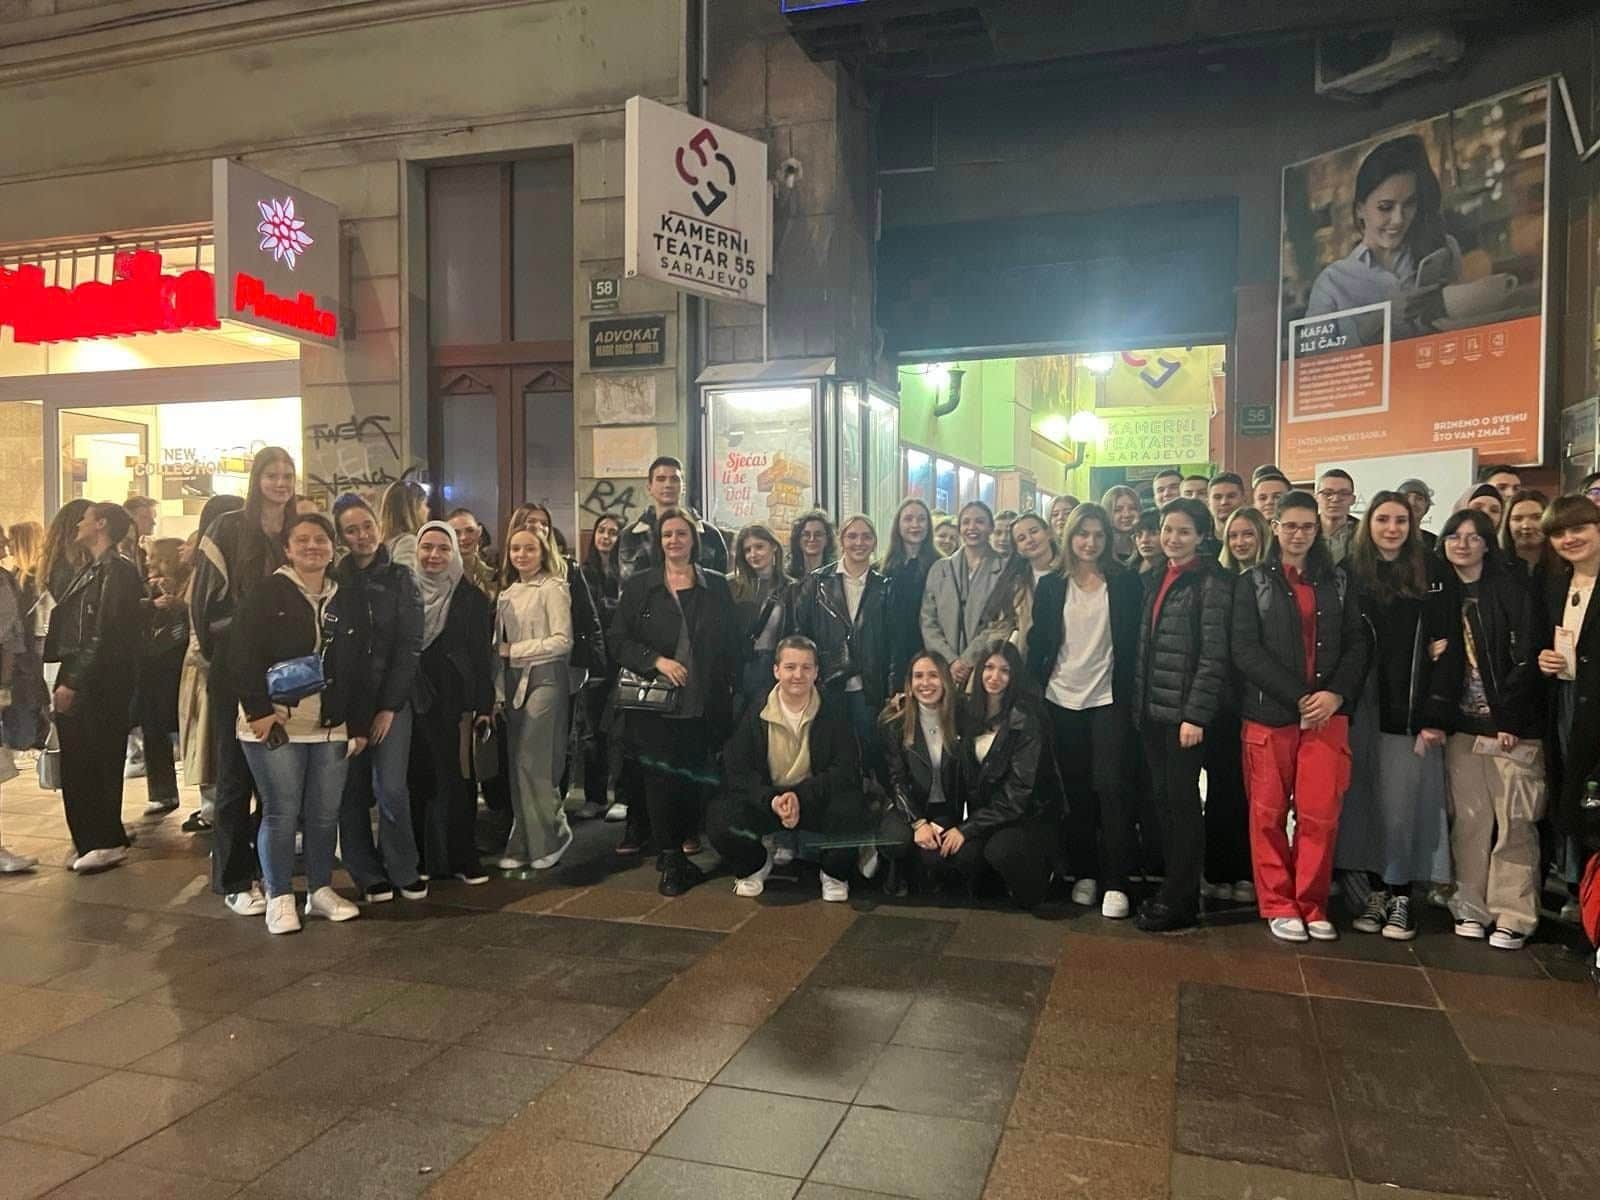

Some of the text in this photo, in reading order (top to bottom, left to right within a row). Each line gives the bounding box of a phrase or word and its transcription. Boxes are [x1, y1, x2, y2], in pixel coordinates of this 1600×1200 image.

[661, 214, 748, 254] KAMERNI
[653, 233, 755, 275] TEATAR 55
[661, 256, 748, 289] SARAJEVO
[596, 281, 612, 295] 58
[594, 328, 660, 343] ADVOKAT
[1300, 323, 1335, 338] KAFA?
[163, 447, 196, 461] NEW
[1107, 449, 1196, 461] SARAJEVO
[134, 461, 227, 476] COLLECTION
